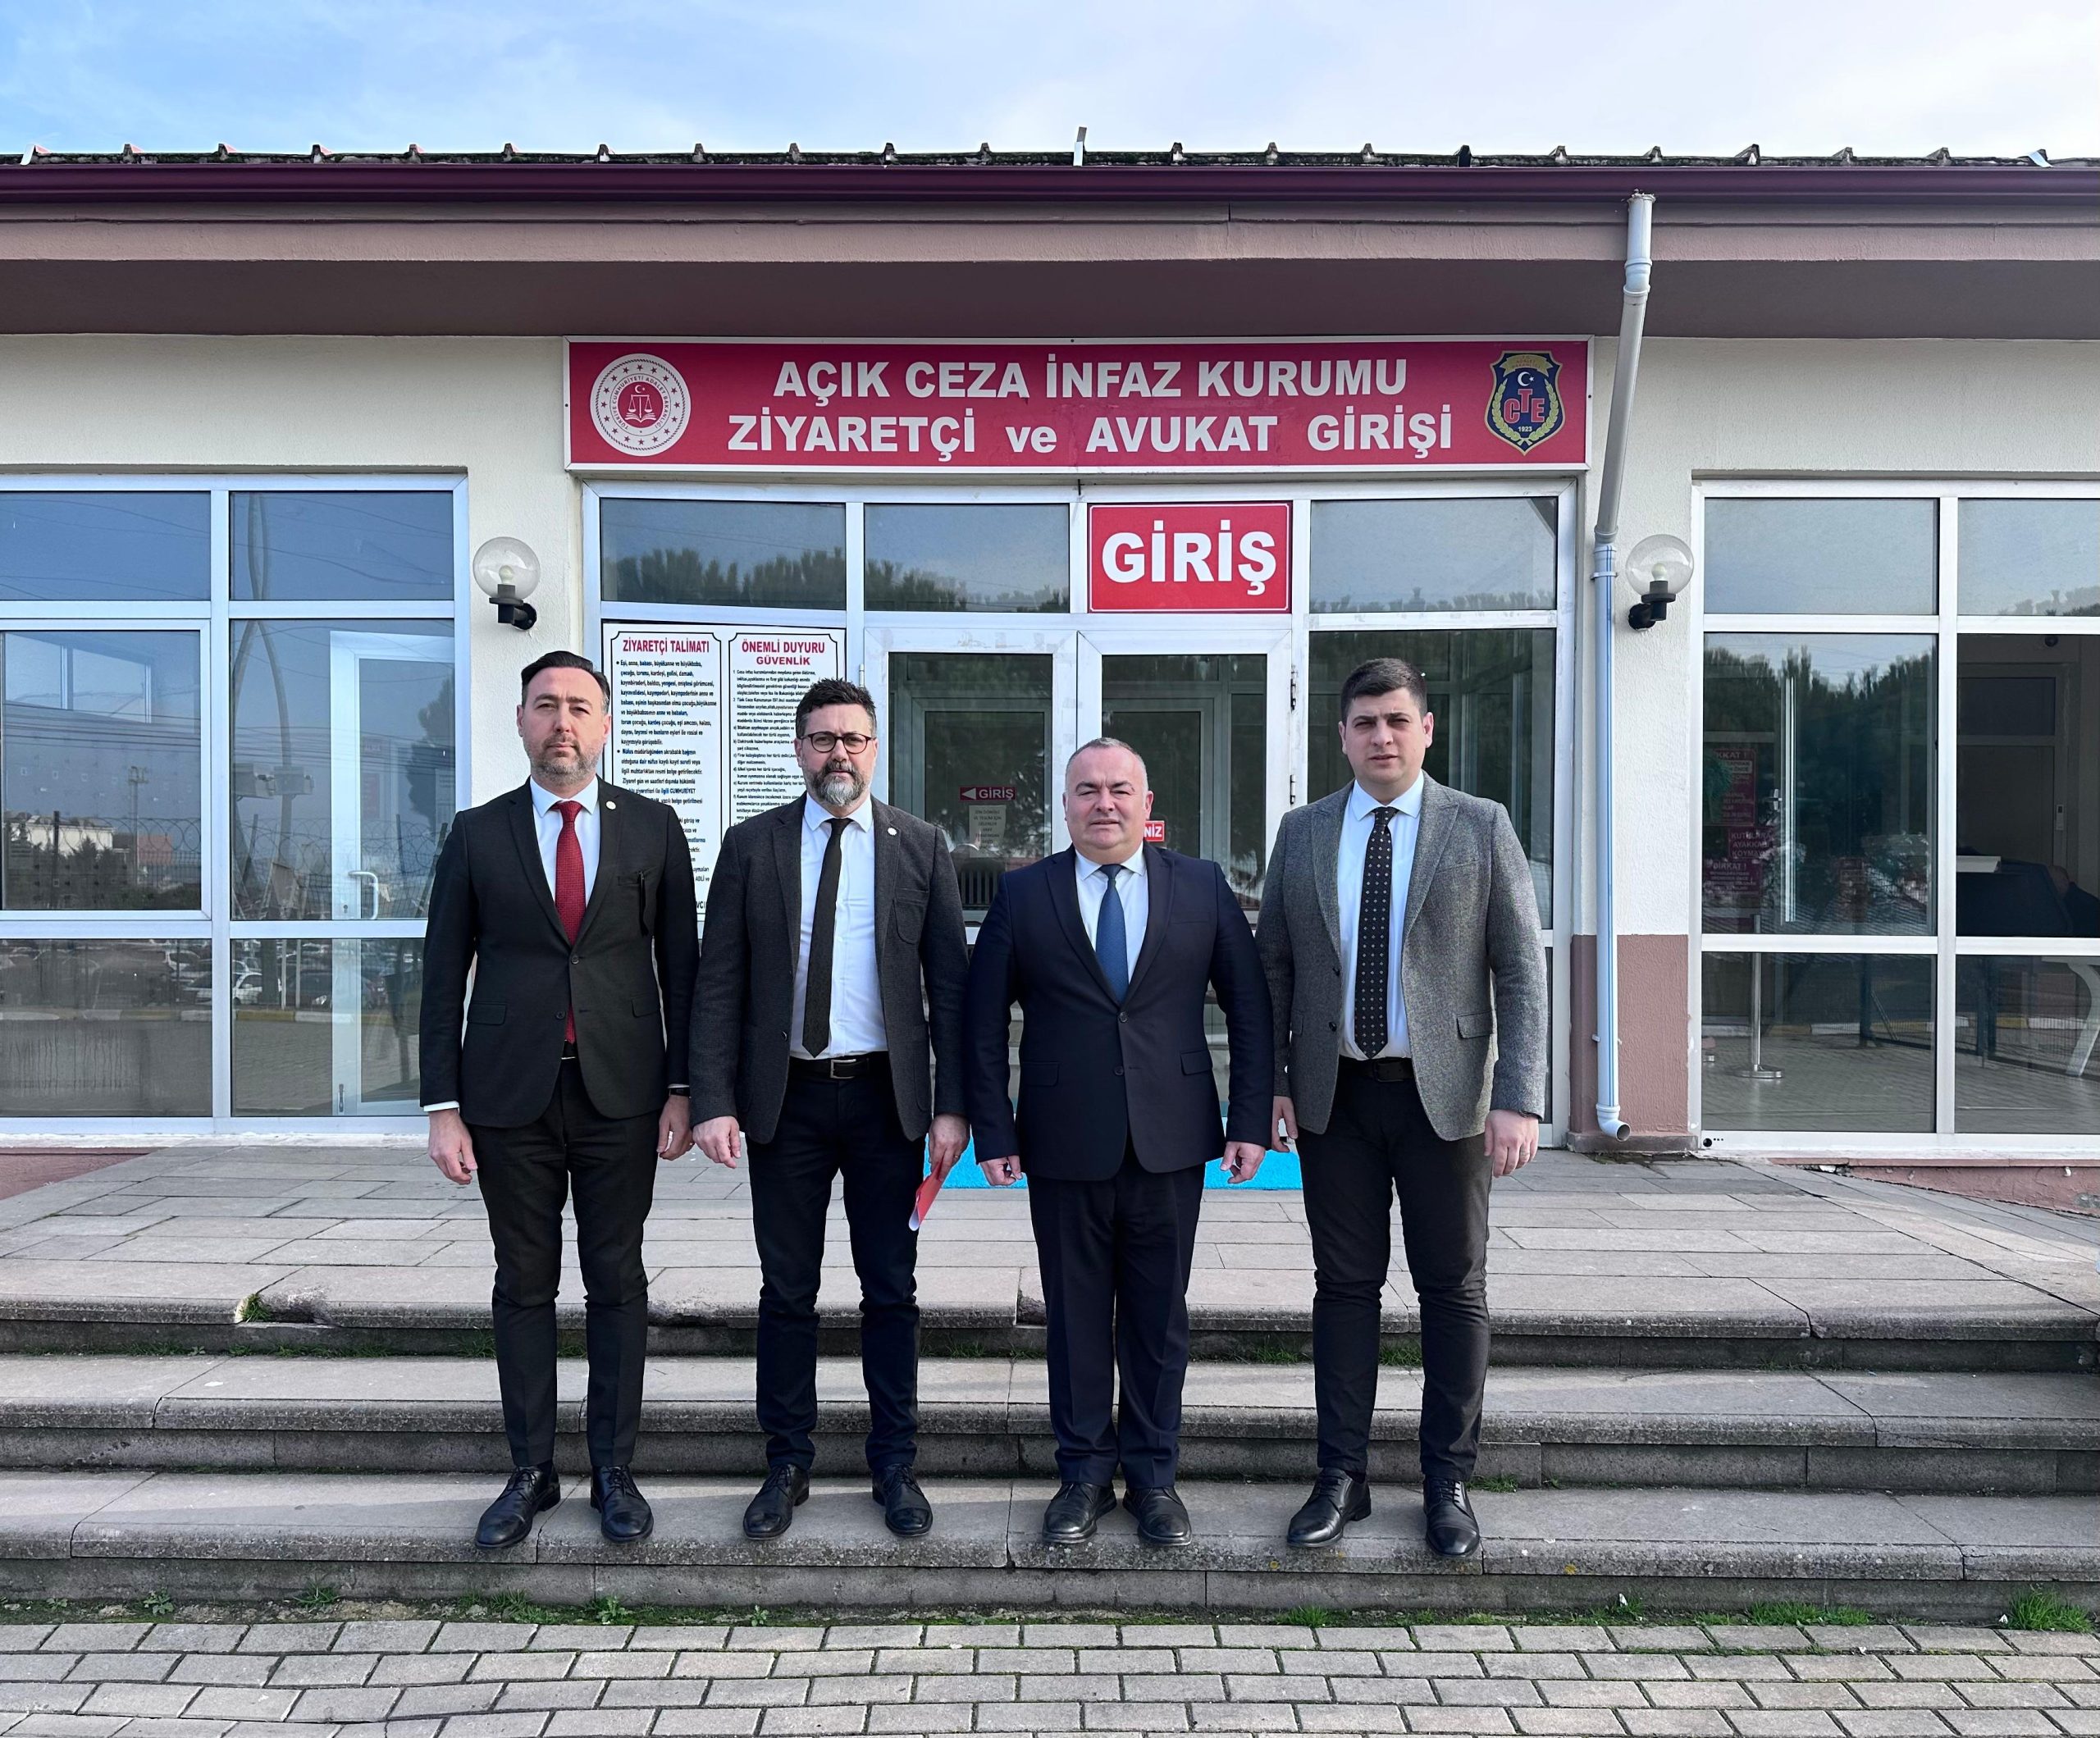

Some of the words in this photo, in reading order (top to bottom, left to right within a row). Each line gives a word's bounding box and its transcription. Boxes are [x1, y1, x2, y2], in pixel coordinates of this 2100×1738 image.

[645, 376, 665, 396] ADALET
[773, 362, 890, 408] AÇIK
[905, 361, 1030, 399] CEZA
[1046, 354, 1181, 399] İNFAZ
[1198, 359, 1407, 398] KURUMU
[728, 407, 975, 458] ZİYARETÇİ
[1005, 426, 1057, 454] ve
[1084, 415, 1278, 453] AVUKAT
[1312, 404, 1452, 460] GİRİŞİ
[1102, 520, 1277, 596] GİRİŞ
[623, 636, 668, 655] ZİYARETÇİ
[670, 637, 710, 653] TALİMATI
[742, 639, 780, 653] ÖNEMLİ
[783, 641, 825, 654] DUYURU
[756, 655, 810, 666] GÜVENLİK
[979, 787, 1014, 801] GİRİŞ
[1144, 823, 1162, 837] NİZ
